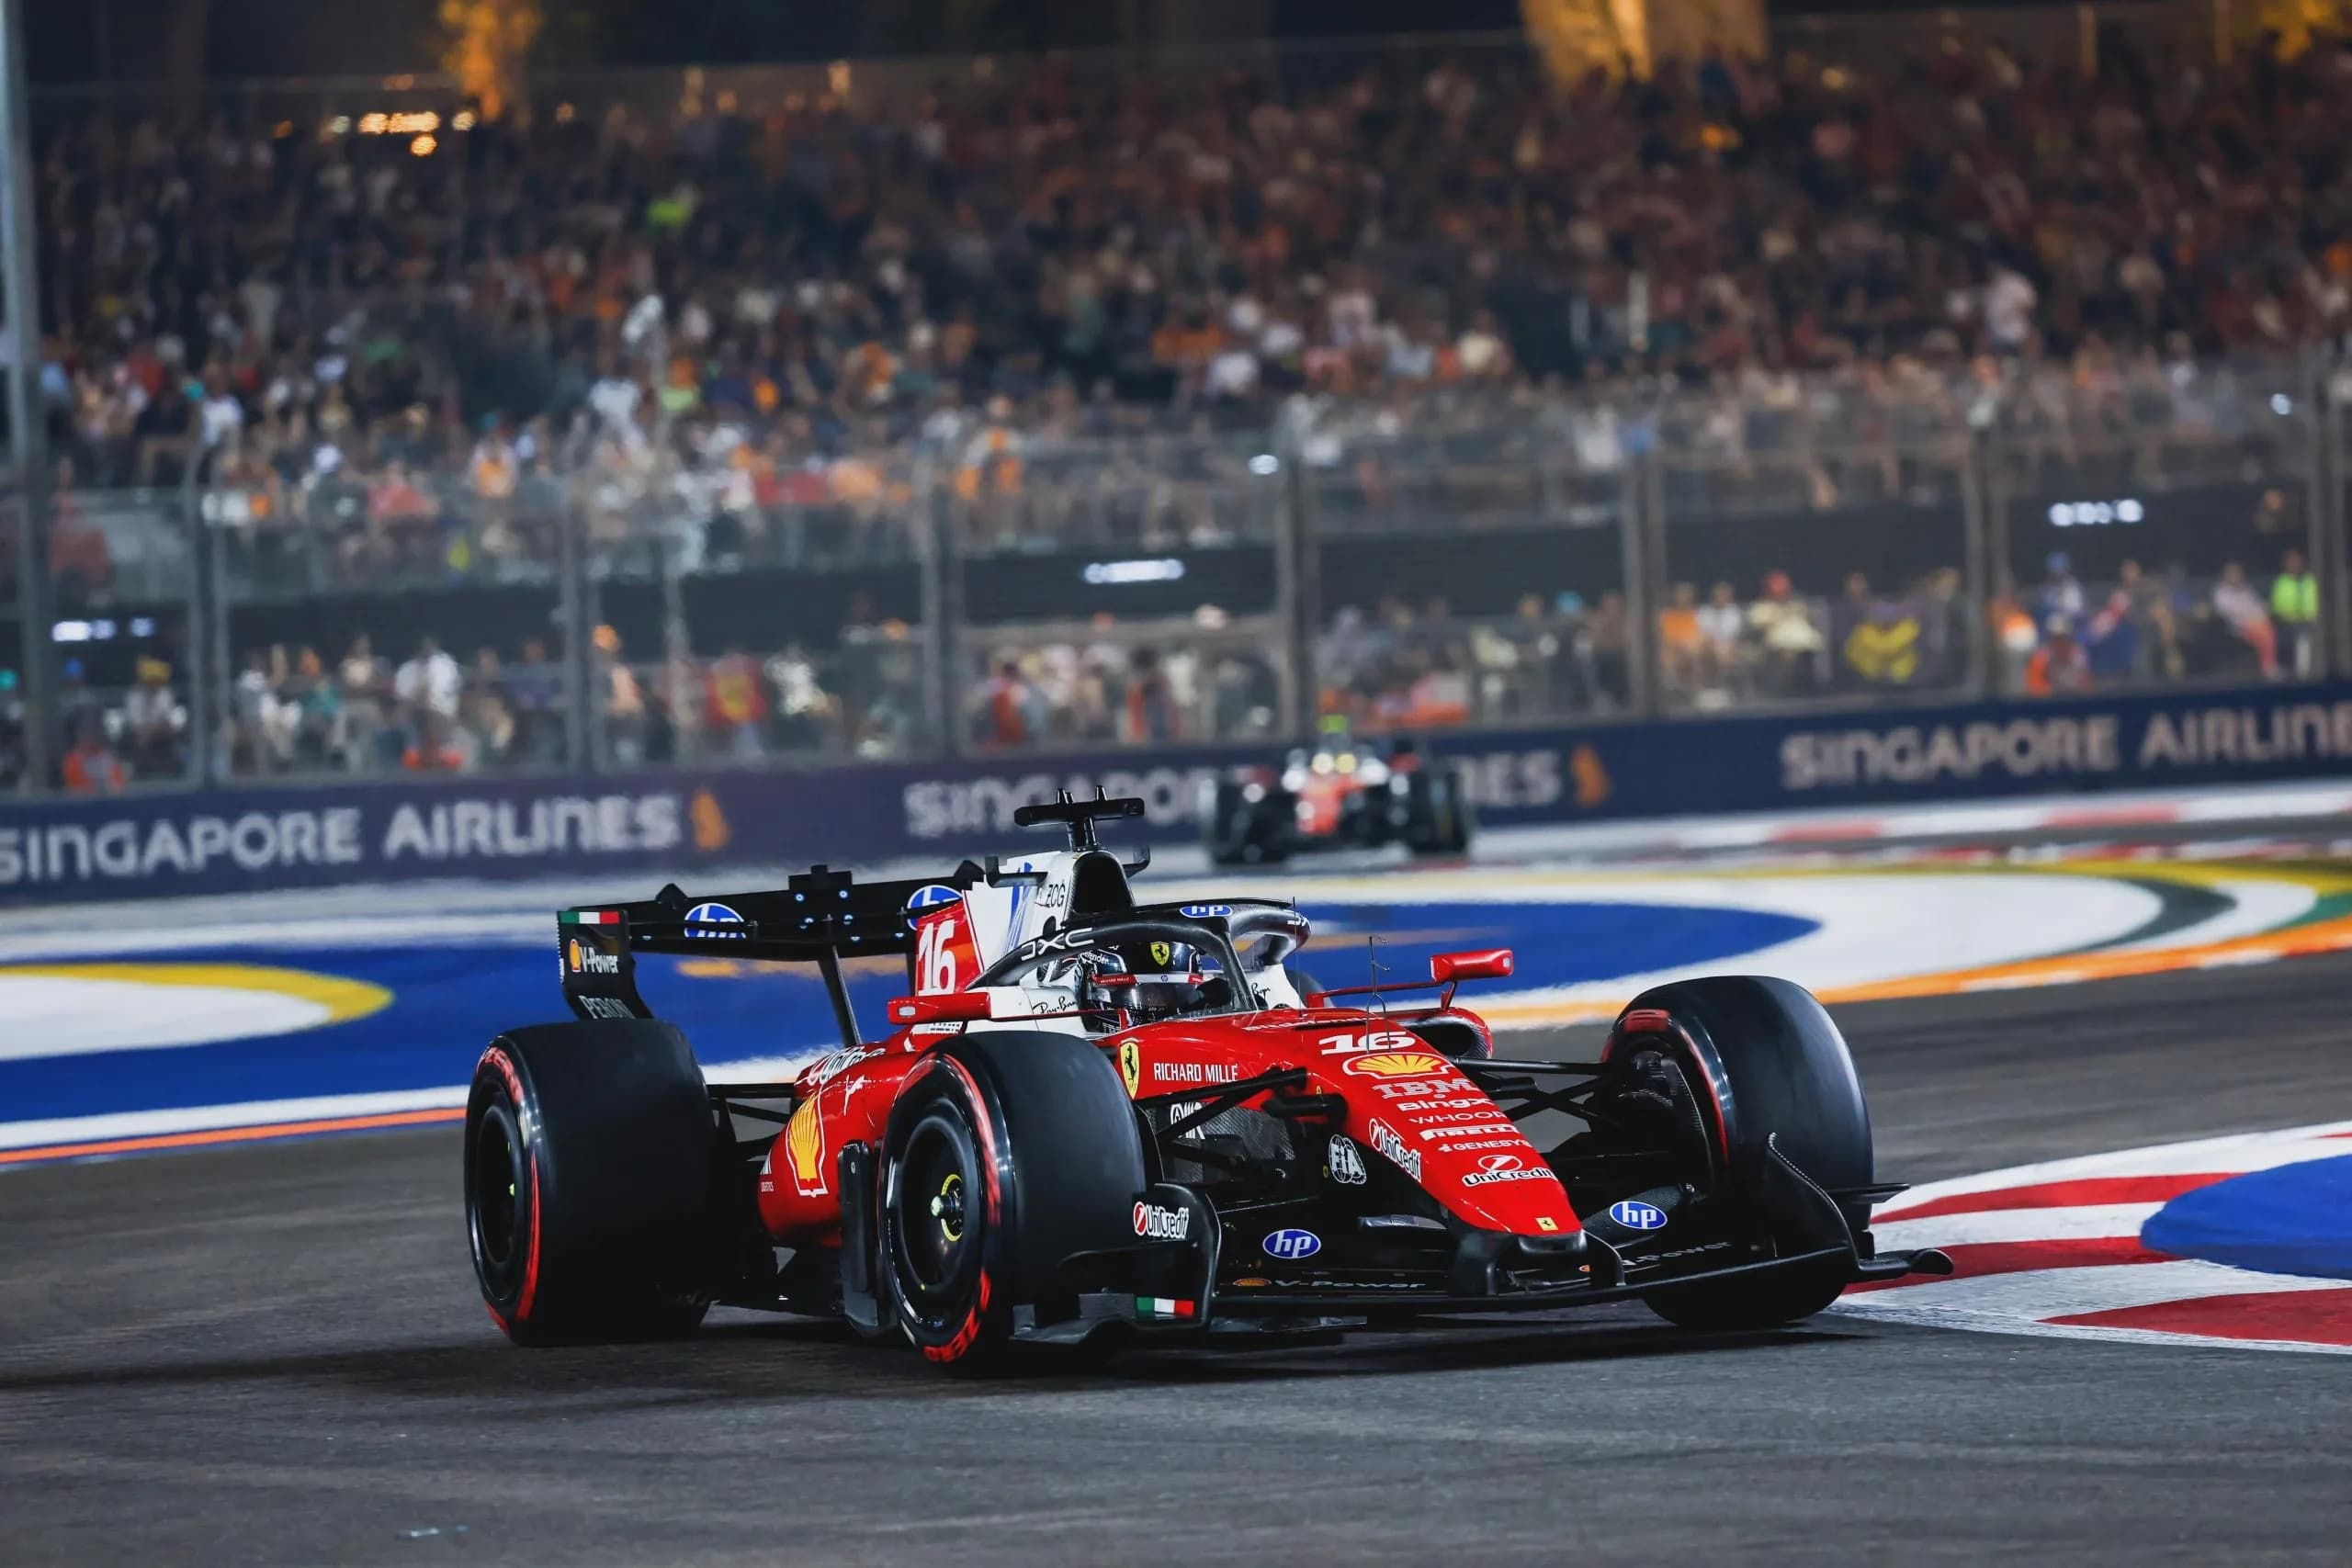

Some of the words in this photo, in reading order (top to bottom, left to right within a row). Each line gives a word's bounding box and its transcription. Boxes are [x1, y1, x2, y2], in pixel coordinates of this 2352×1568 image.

[1781, 716, 2120, 788] SINGAPORE
[0, 807, 361, 885] SINGAPORE
[383, 793, 682, 860] AIRLINES
[1192, 906, 1223, 917] hp
[579, 946, 618, 974] V-Power
[918, 919, 956, 997] 16
[1318, 1031, 1416, 1055] 16
[1154, 1063, 1202, 1081] RICHARD
[1205, 1064, 1238, 1082] MILLE
[1373, 1077, 1477, 1100] IBM
[1379, 1125, 1421, 1183] UniCredit
[1146, 1205, 1190, 1239] UniCredit
[1622, 1201, 1657, 1229] hp
[1274, 1230, 1312, 1258] hp
